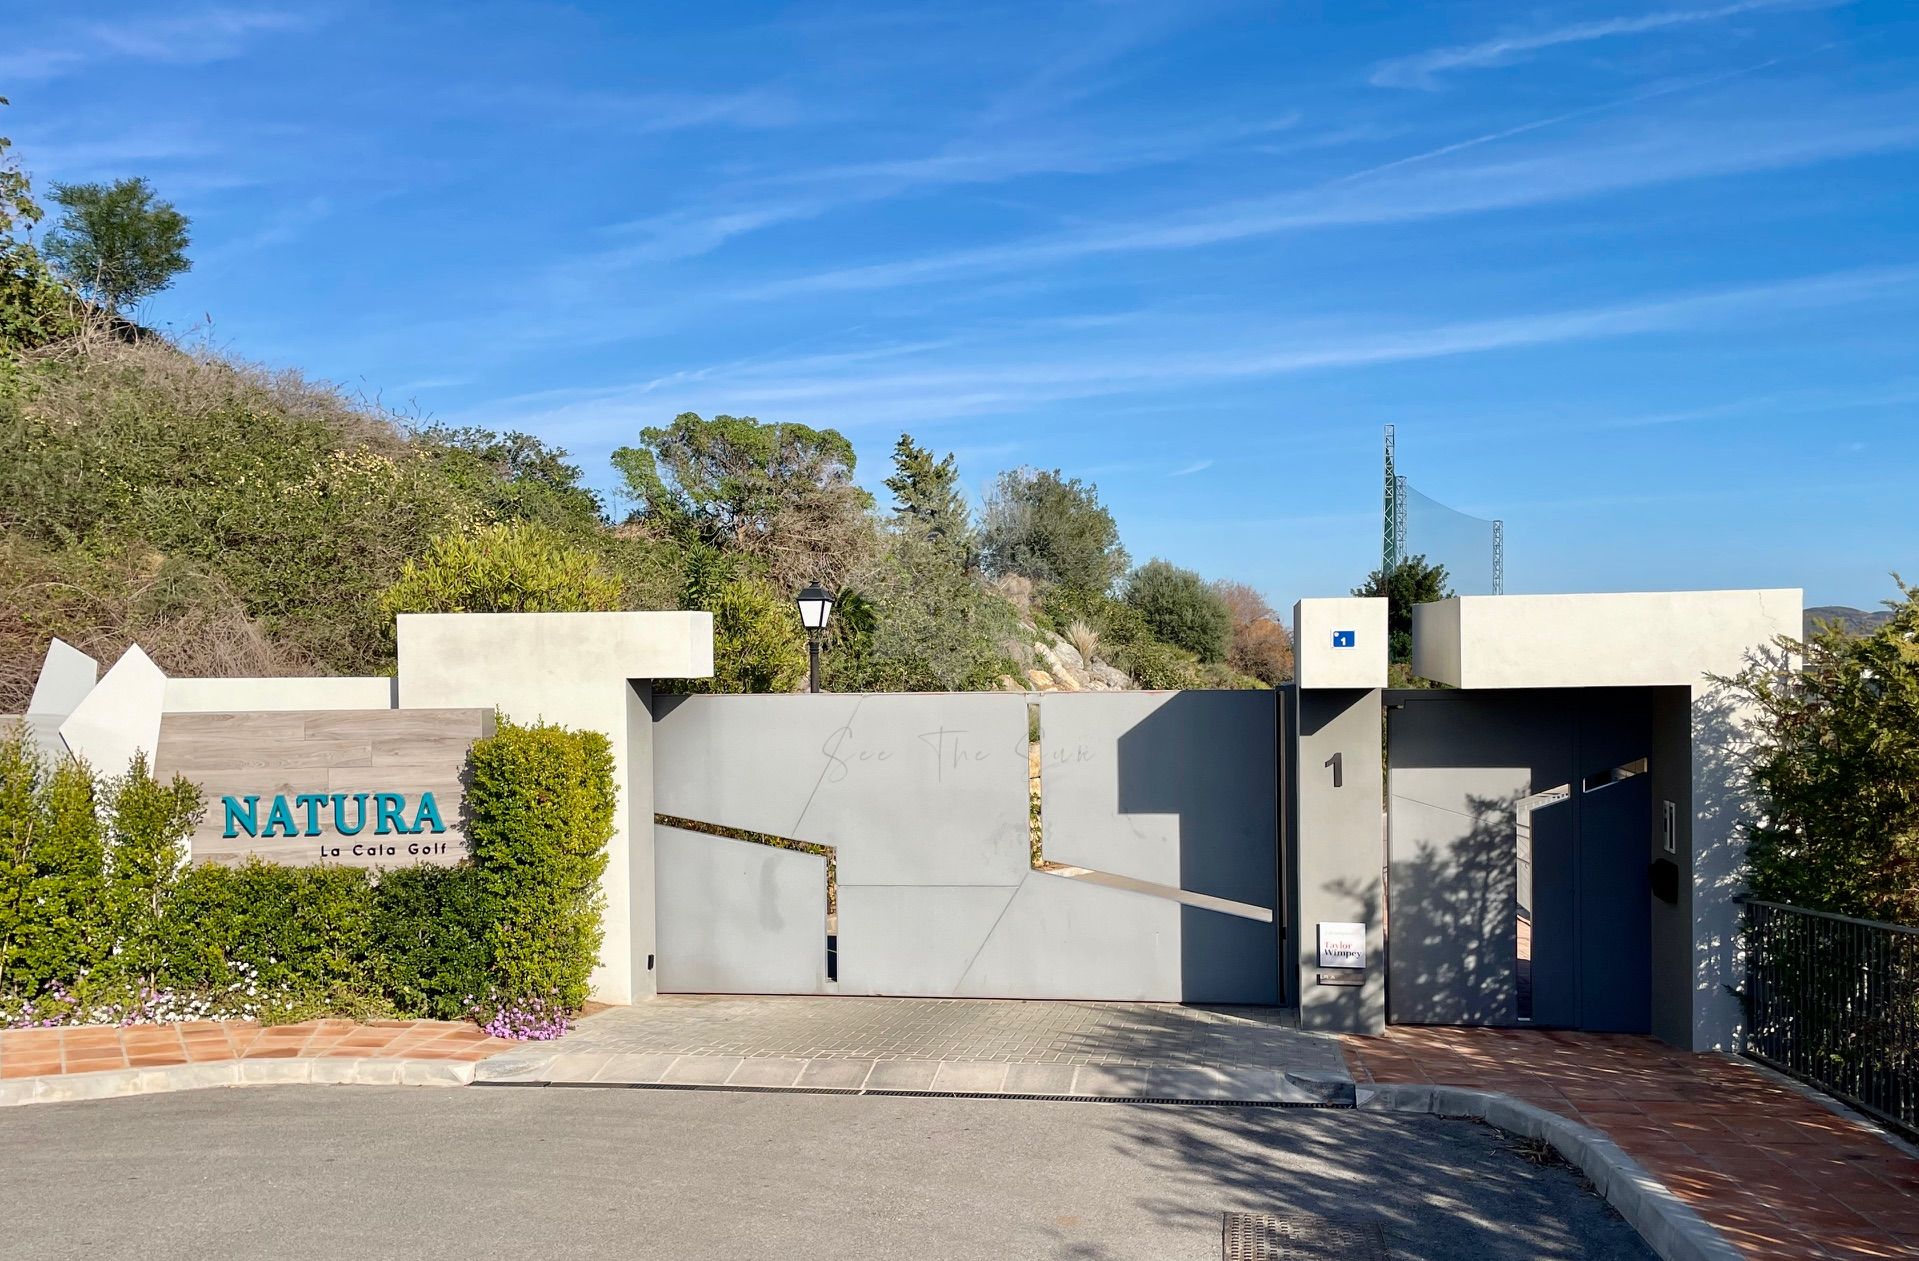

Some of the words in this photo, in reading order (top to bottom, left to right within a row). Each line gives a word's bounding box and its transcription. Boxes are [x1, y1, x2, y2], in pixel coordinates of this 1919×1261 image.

[1340, 636, 1347, 646] 1
[1324, 751, 1343, 788] 1
[222, 791, 447, 838] NATURA
[321, 844, 341, 857] La
[353, 843, 396, 857] Cala
[408, 842, 448, 856] Golf
[1325, 941, 1352, 949] Taylor
[1324, 949, 1361, 959] Wimpey
